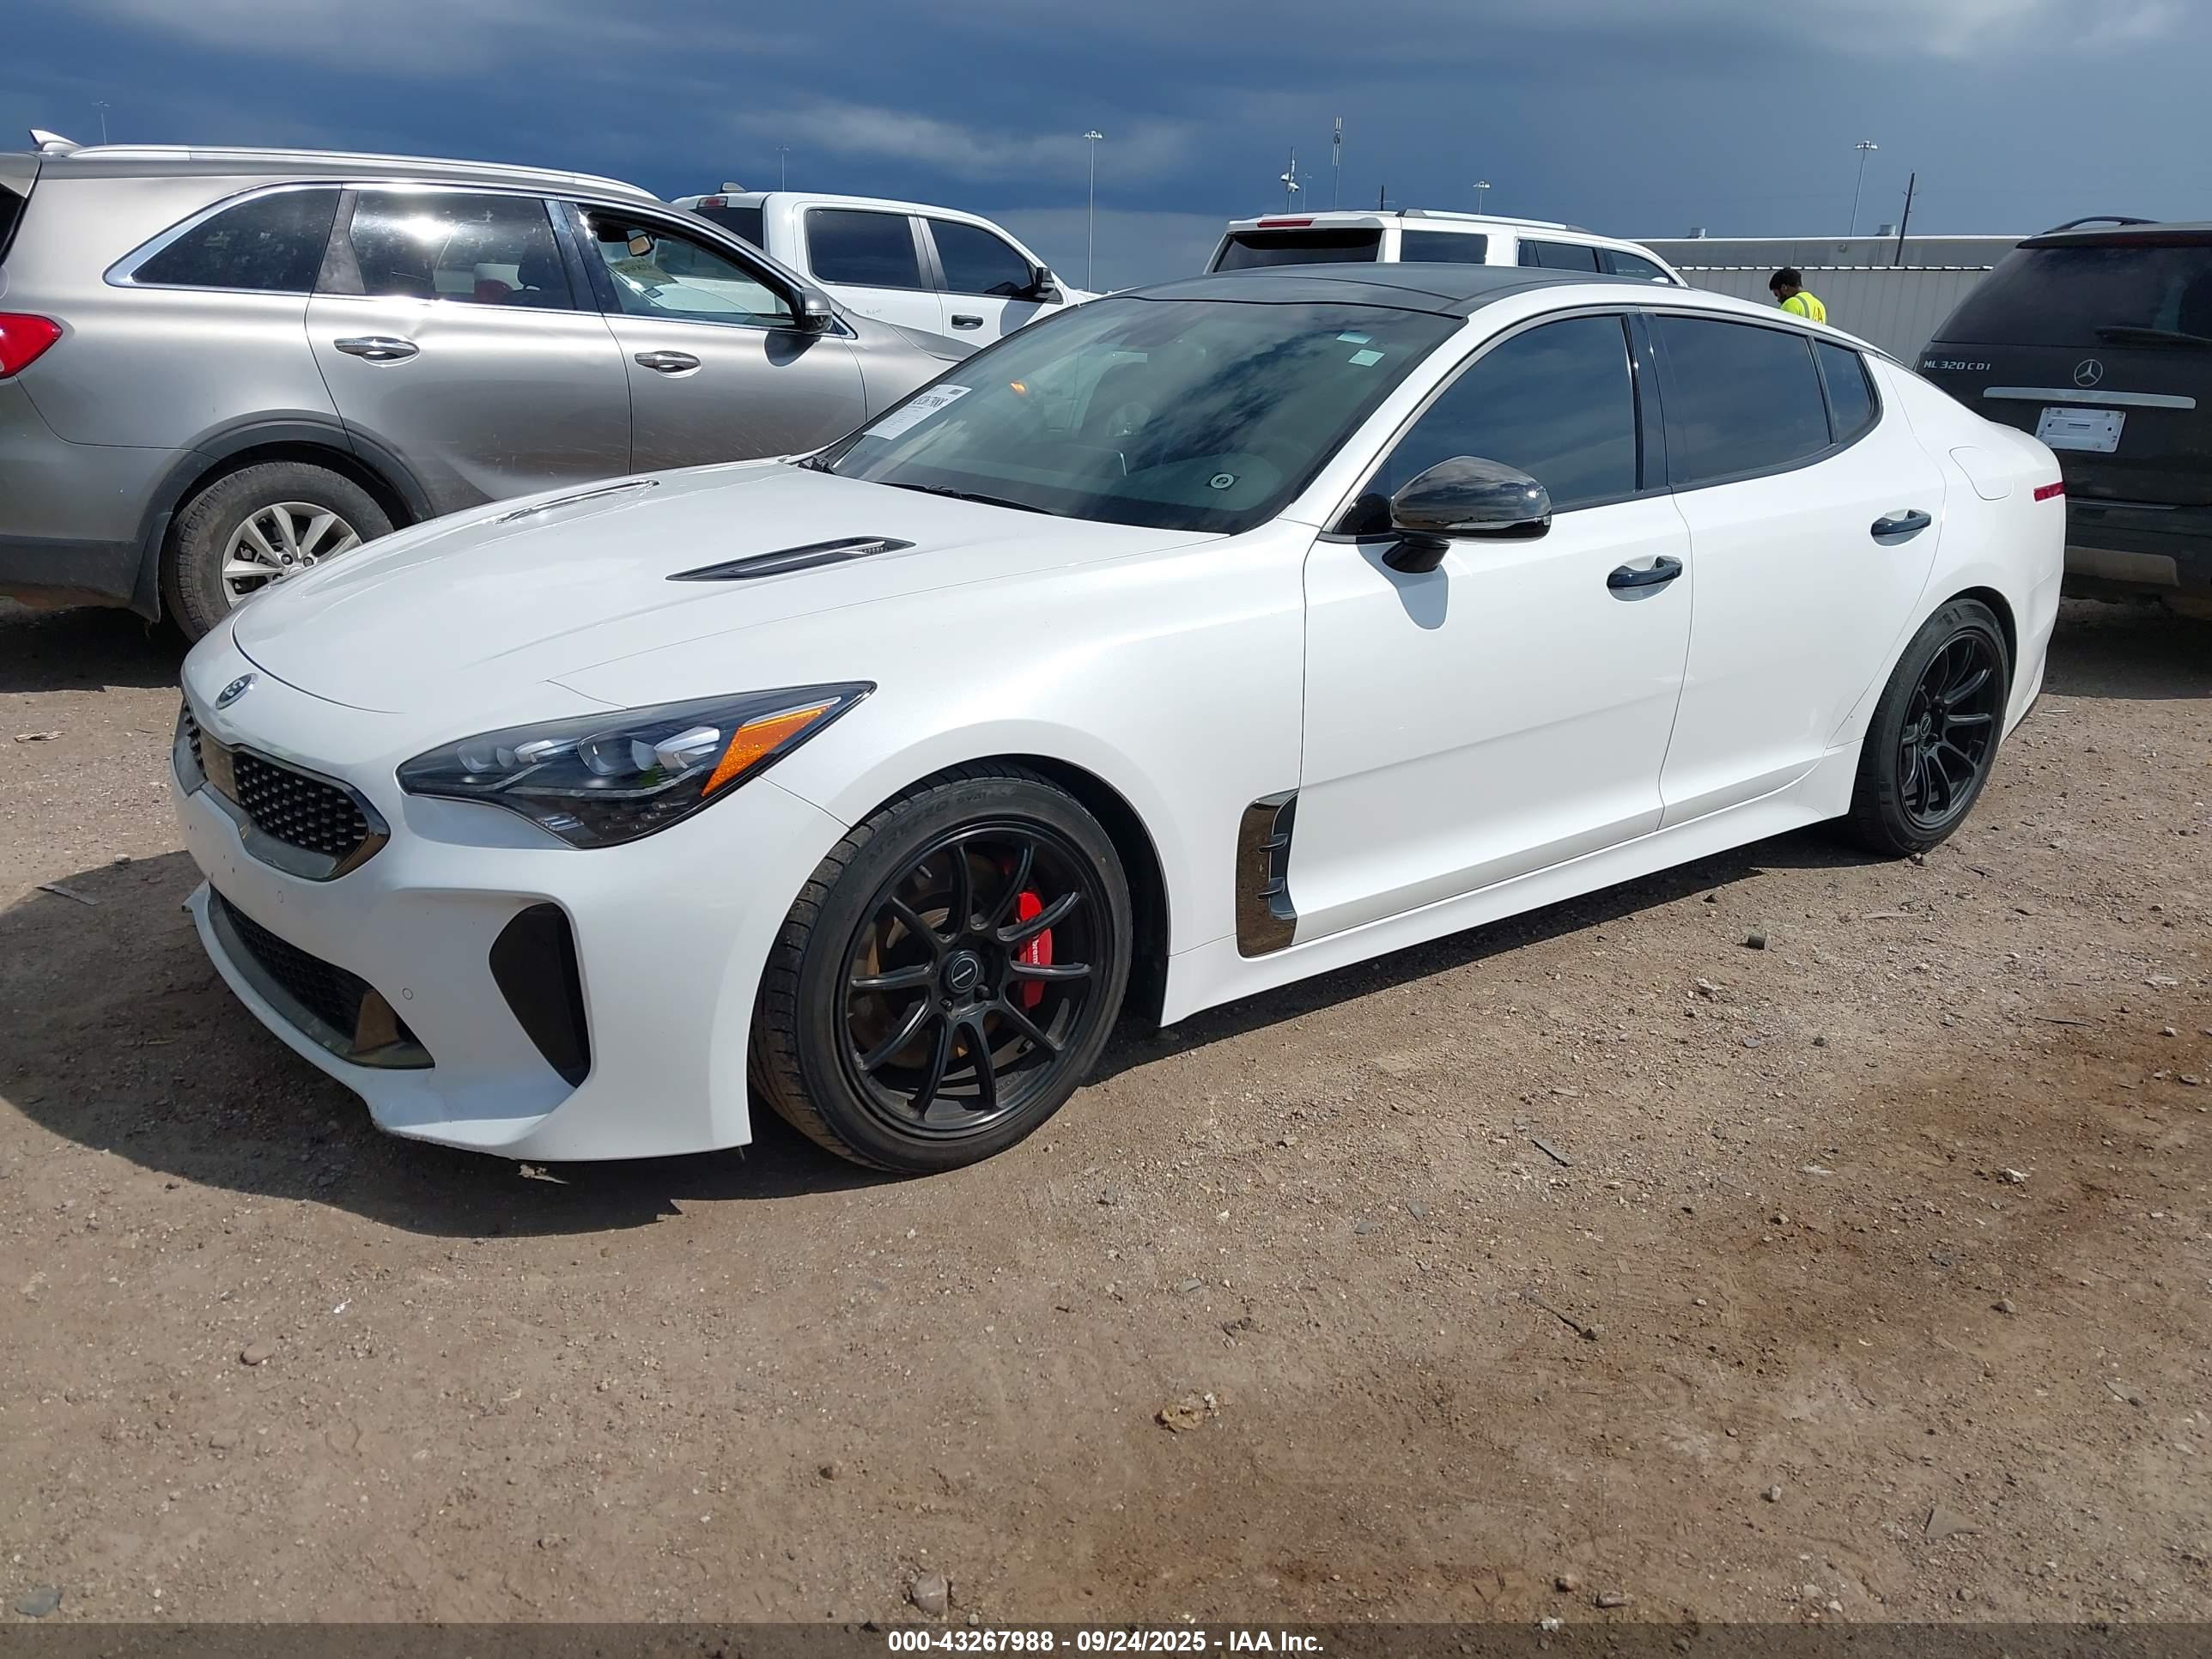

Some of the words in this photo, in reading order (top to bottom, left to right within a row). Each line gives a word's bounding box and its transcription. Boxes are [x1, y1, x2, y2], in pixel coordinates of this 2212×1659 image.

[1923, 360, 1938, 369] ML
[1939, 361, 1966, 370] 320
[1966, 362, 1991, 371] CDI
[1031, 939, 1040, 965] brem
